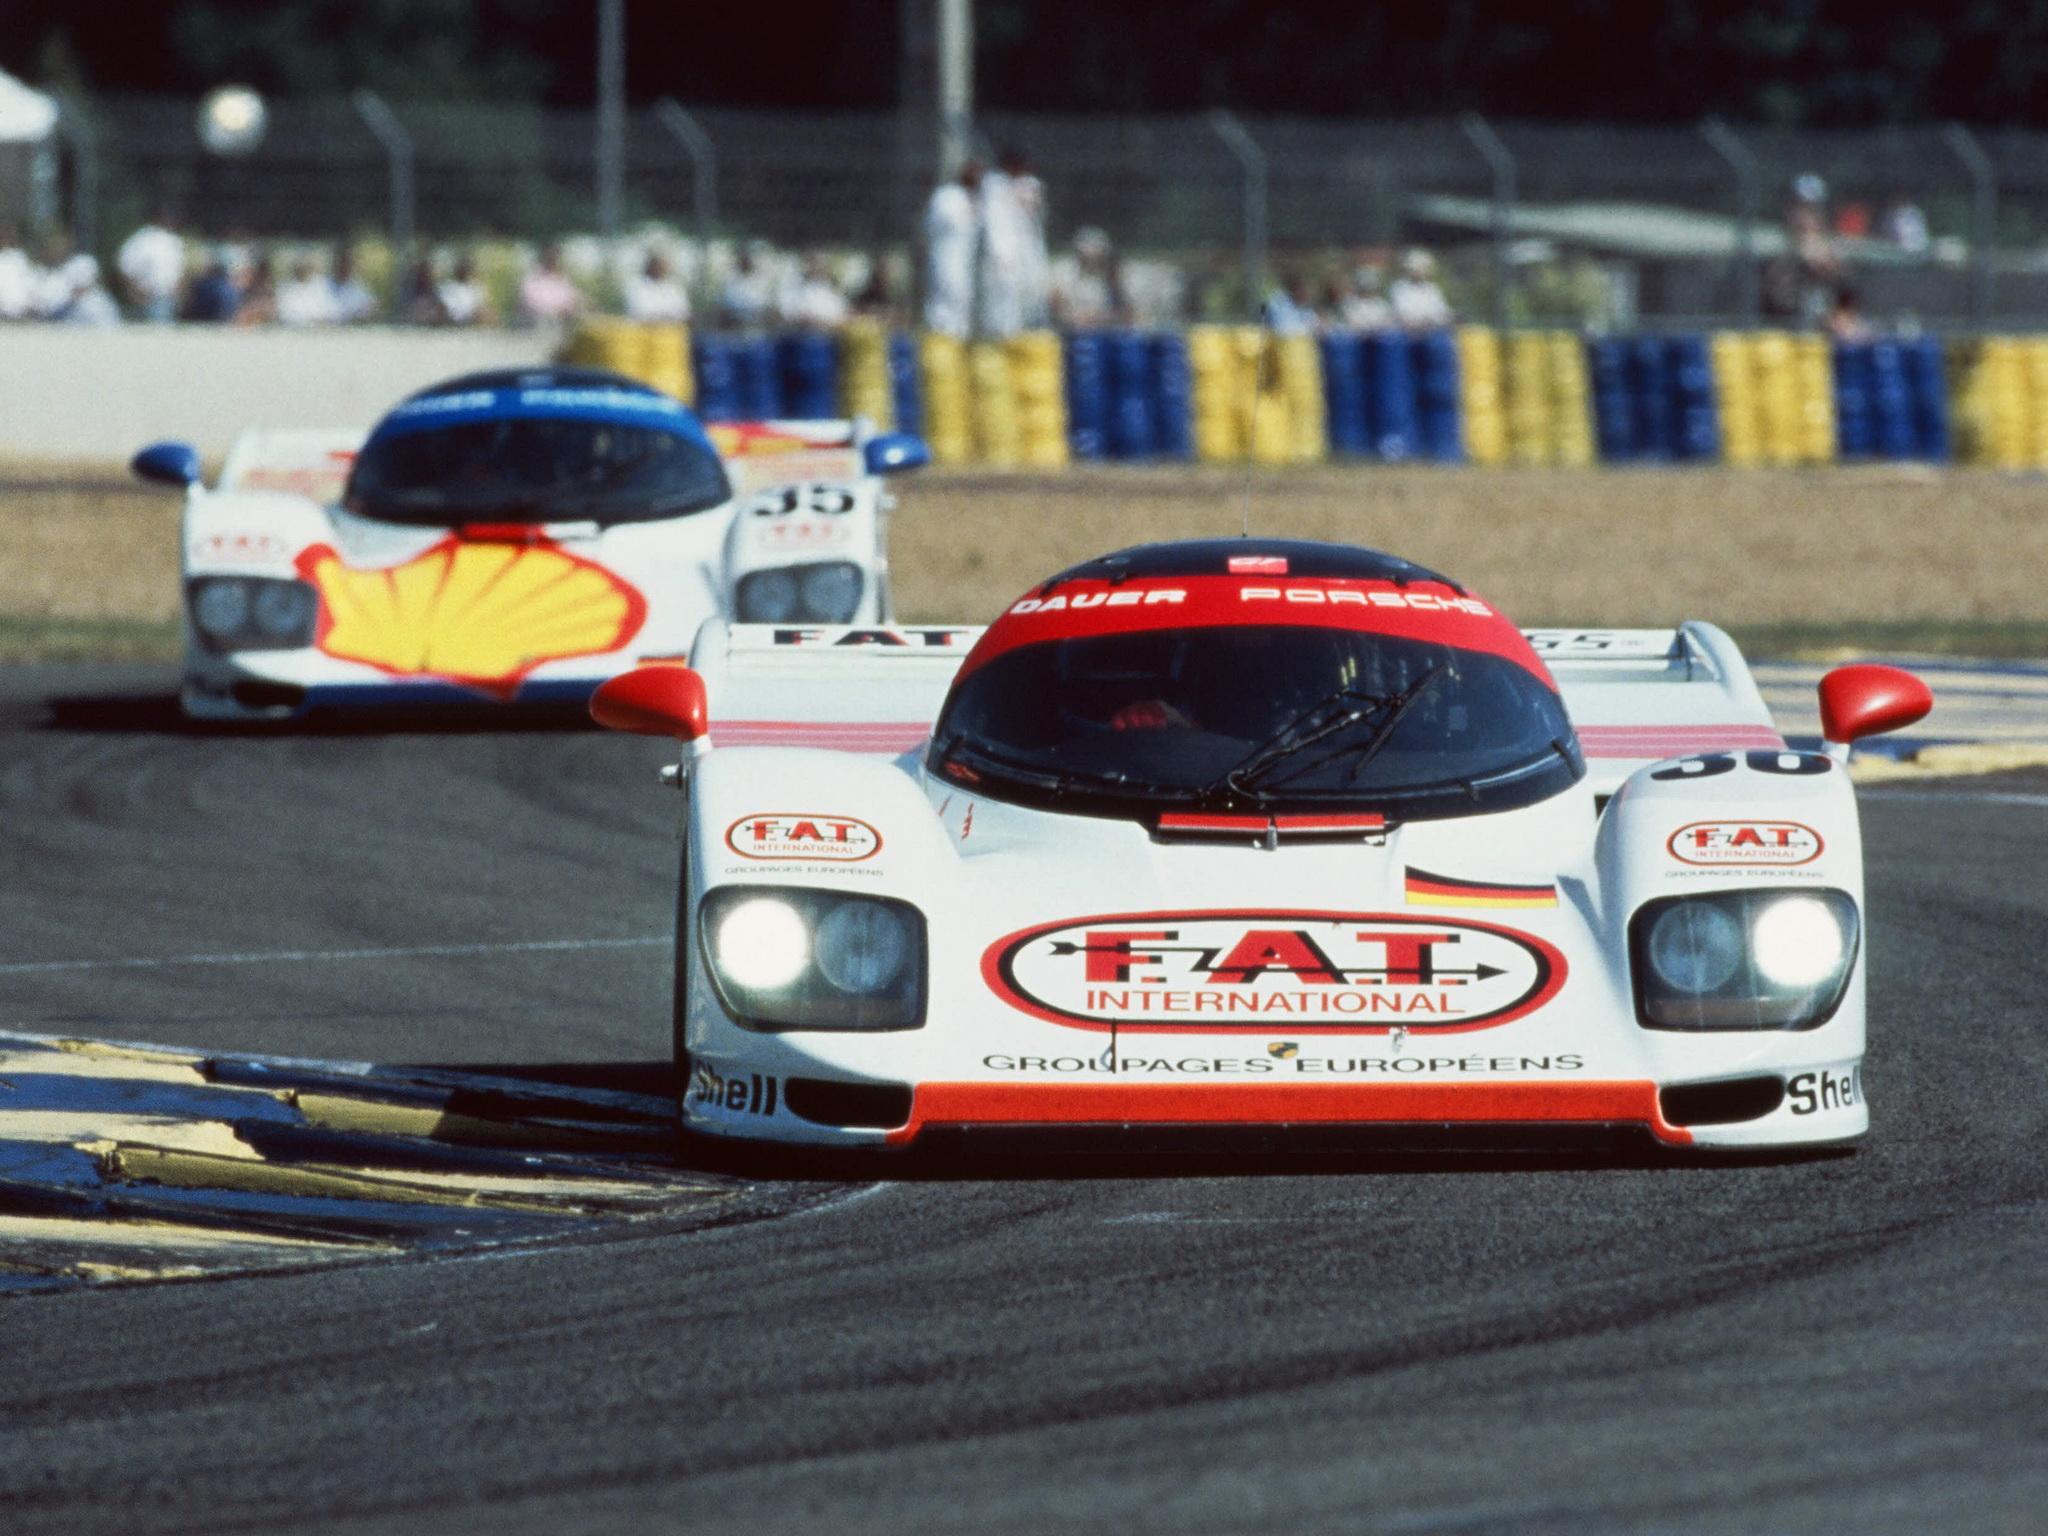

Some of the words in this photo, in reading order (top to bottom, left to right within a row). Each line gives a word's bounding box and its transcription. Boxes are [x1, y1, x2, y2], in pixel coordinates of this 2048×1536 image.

[754, 486, 855, 516] 35
[1011, 589, 1187, 615] DAUER
[1241, 588, 1494, 618] PORSCHE
[774, 629, 969, 646] FAT
[753, 844, 854, 855] INTERNATIONAL
[1696, 849, 1795, 858] INTERNATIONAL
[1086, 989, 1466, 1014] INTERNATIONAL
[983, 1053, 1273, 1074] GROUPAGES
[1297, 1050, 1585, 1073] EUROPÉENS
[696, 1062, 777, 1116] Shell
